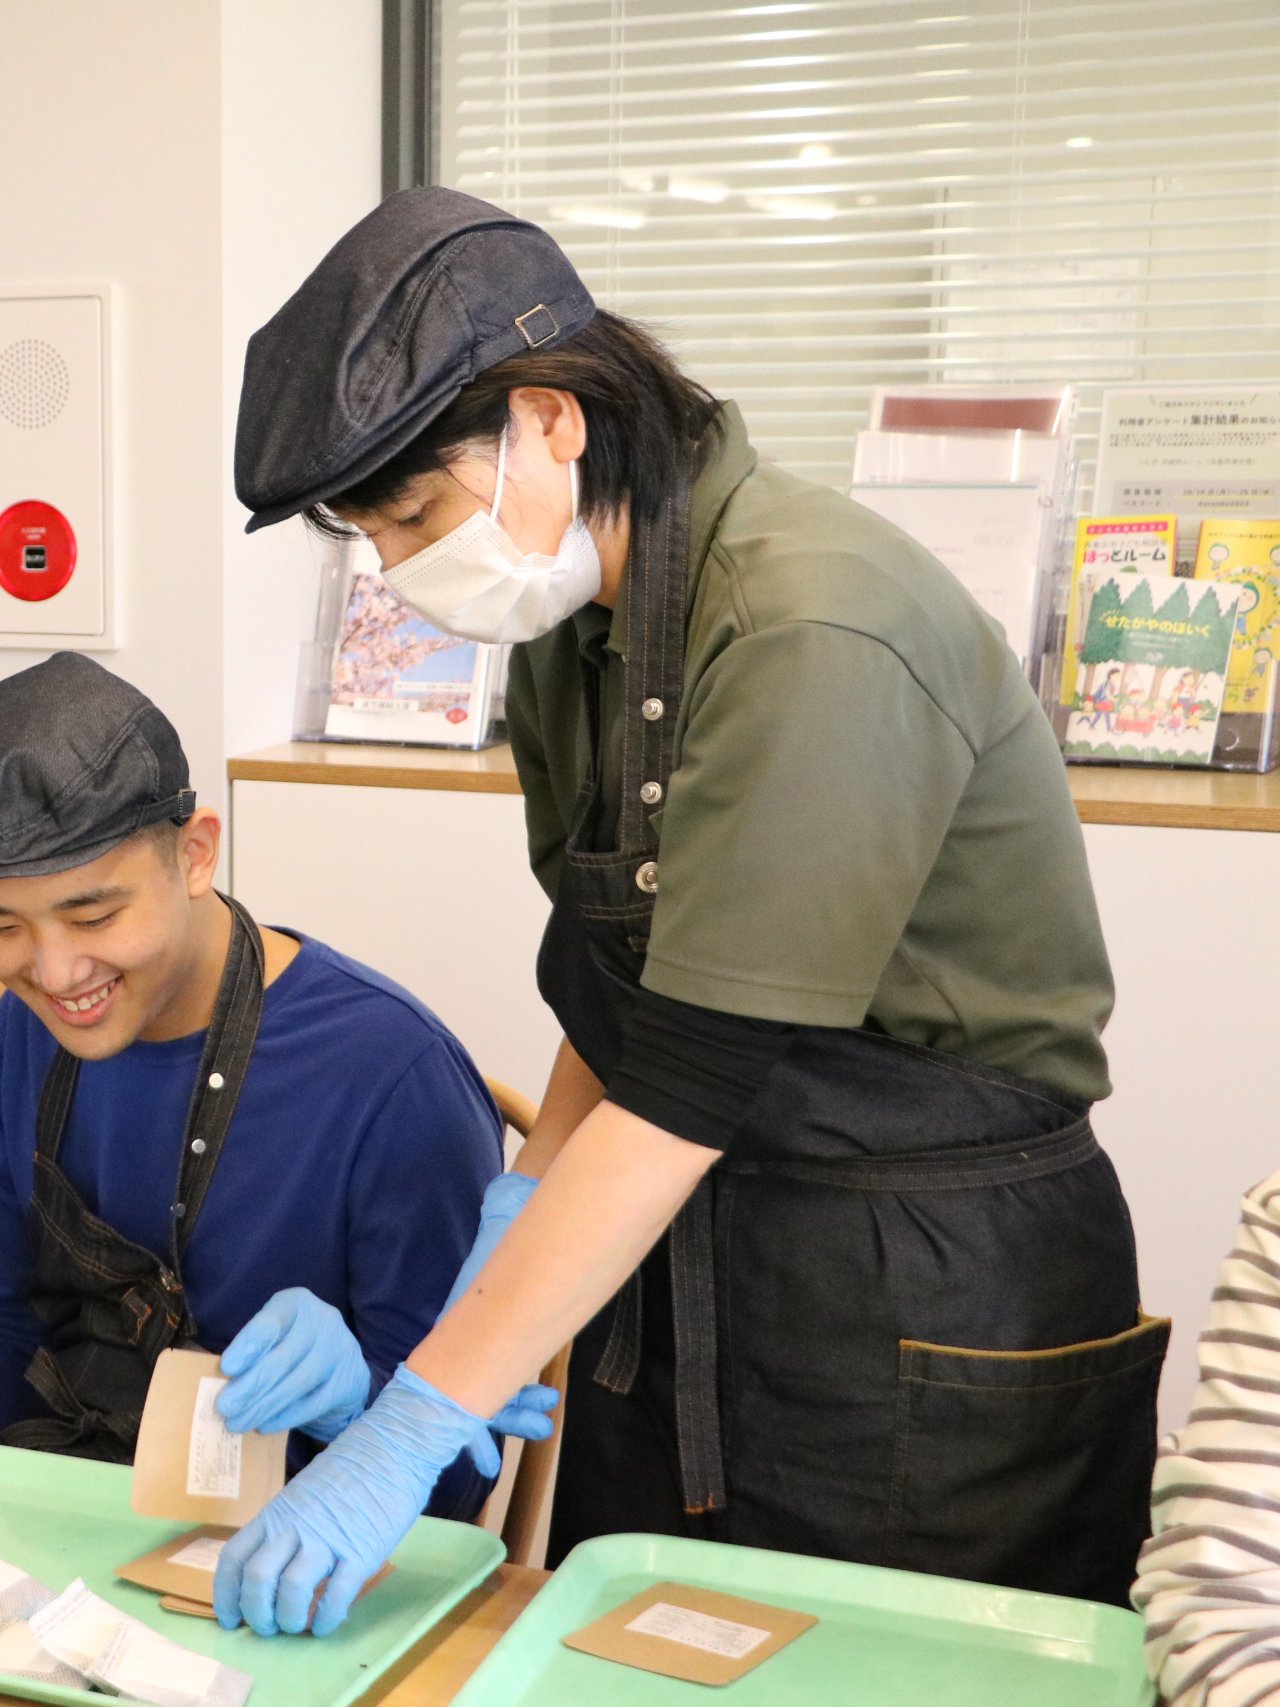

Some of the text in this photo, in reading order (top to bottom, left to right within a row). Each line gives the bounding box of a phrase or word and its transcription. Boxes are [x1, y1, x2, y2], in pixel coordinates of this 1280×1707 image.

[1119, 413, 1280, 427] 利用者アンケート集計結果のお知ら
[1083, 548, 1166, 564] ほっとルーム
[1104, 615, 1211, 638] せたがやのほいく
